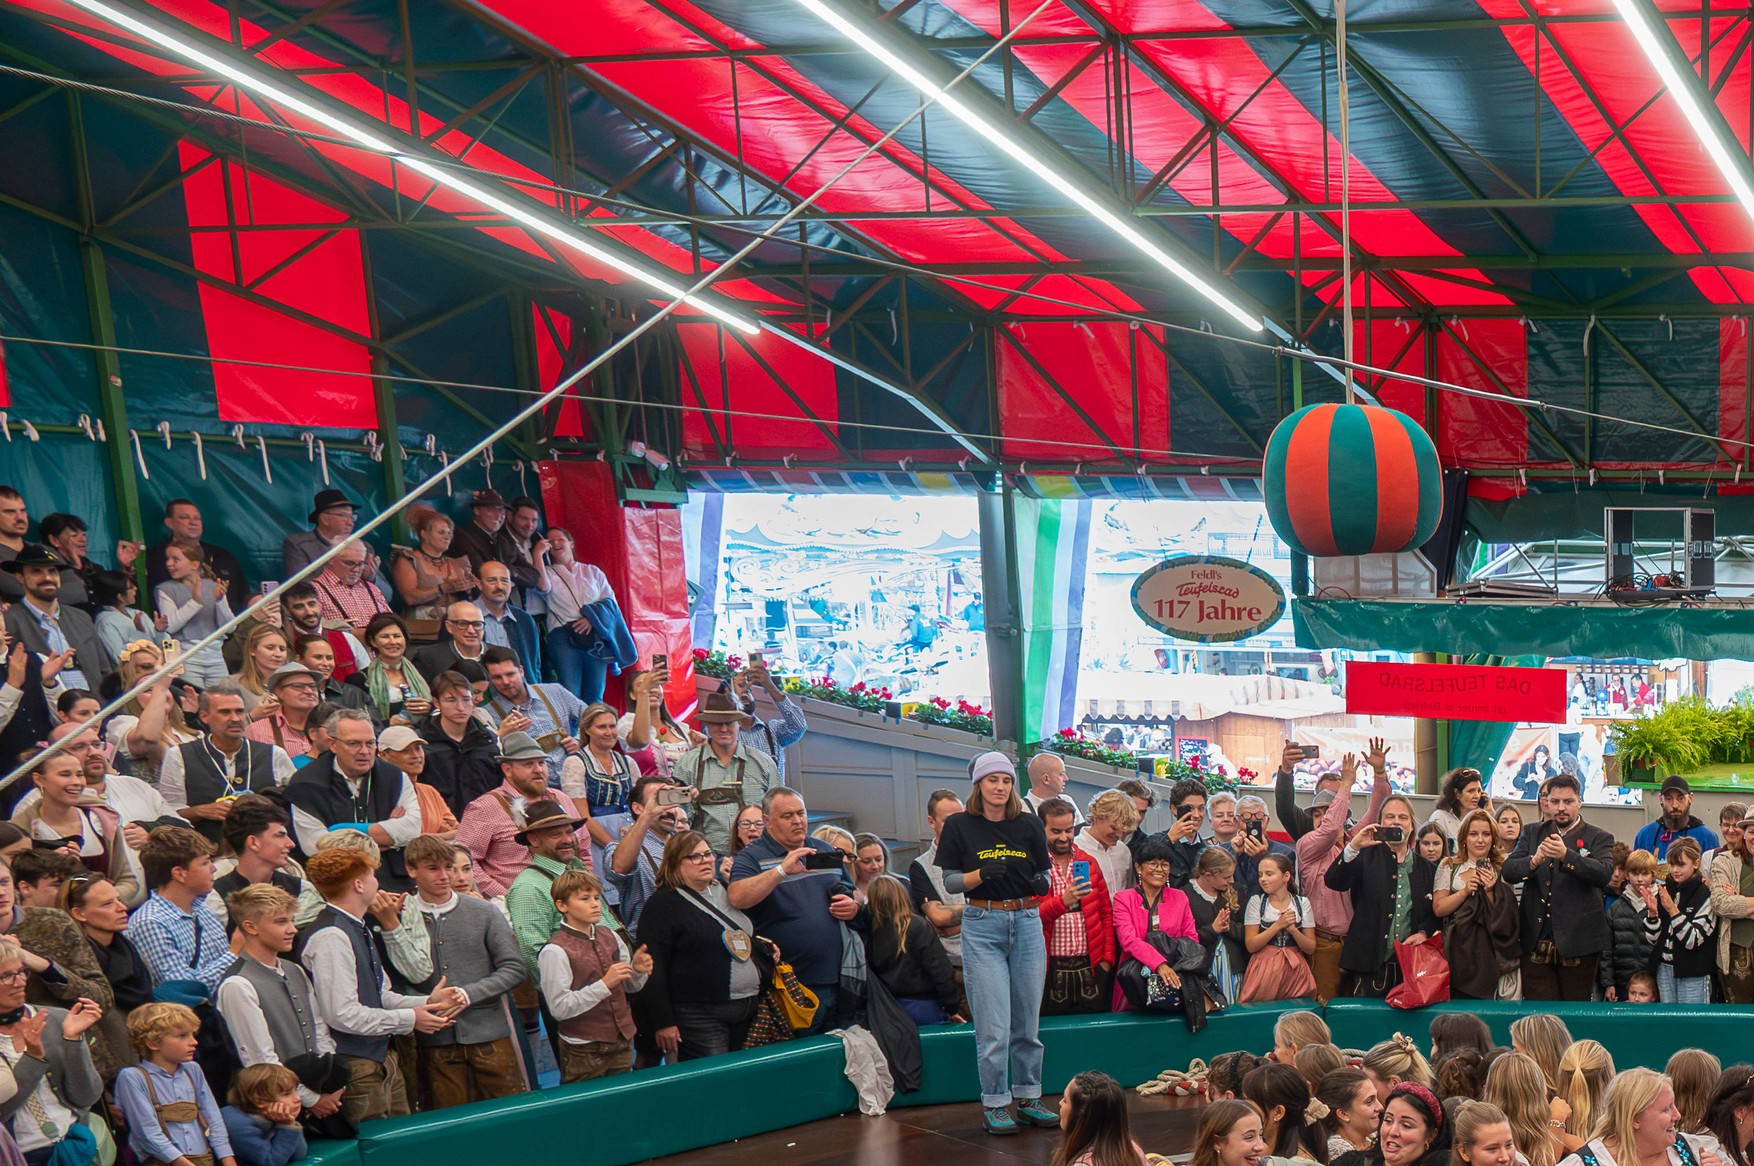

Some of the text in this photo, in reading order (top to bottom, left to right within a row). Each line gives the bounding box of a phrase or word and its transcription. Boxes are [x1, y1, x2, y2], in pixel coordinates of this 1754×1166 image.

[1190, 569, 1222, 580] Feldl's
[1175, 581, 1240, 598] Teufelsrad
[1153, 598, 1262, 623] 117 Jahre
